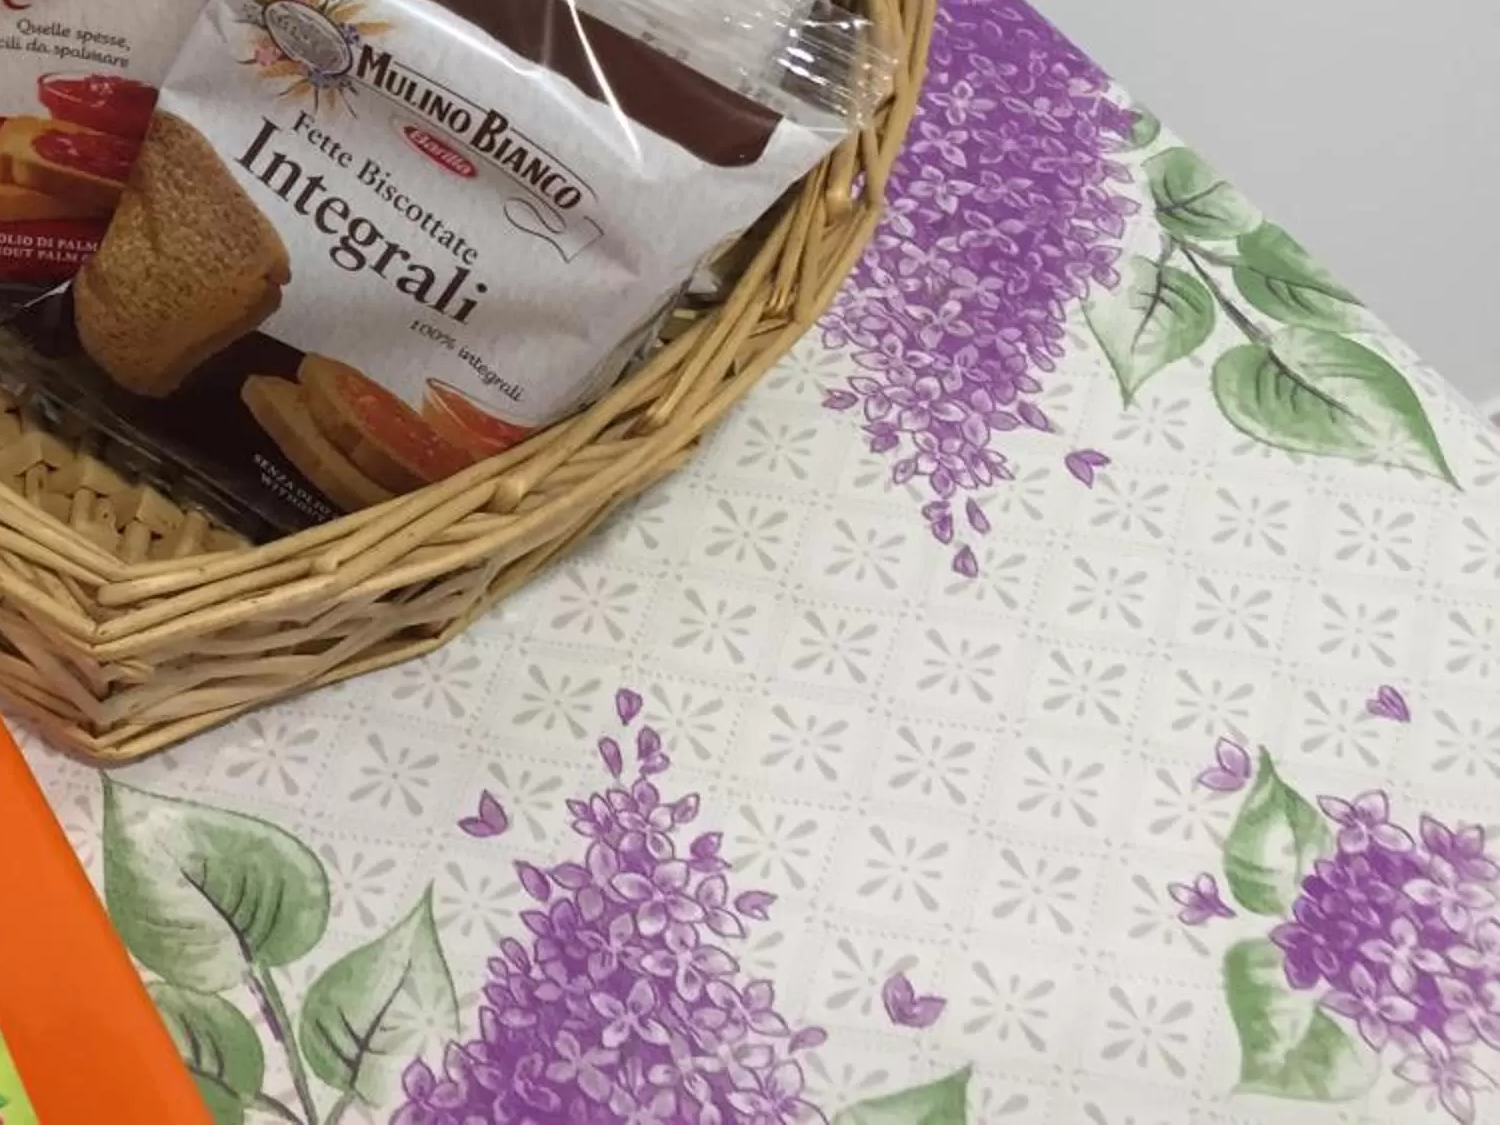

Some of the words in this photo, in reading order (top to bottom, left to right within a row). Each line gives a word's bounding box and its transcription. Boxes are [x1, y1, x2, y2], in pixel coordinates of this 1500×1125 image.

[16, 18, 71, 39] Quelle
[76, 28, 132, 52] spesse,
[25, 38, 48, 54] da
[54, 45, 130, 68] spalmare
[356, 44, 472, 134] MULINO
[470, 108, 582, 210] BIANCO
[292, 110, 353, 168] Fette
[357, 157, 479, 265] Biscottate
[37, 236, 53, 248] DI
[235, 116, 488, 325] Integrali
[38, 250, 78, 262] PALM
[410, 319, 456, 350] 100%
[457, 345, 525, 403] integrali
